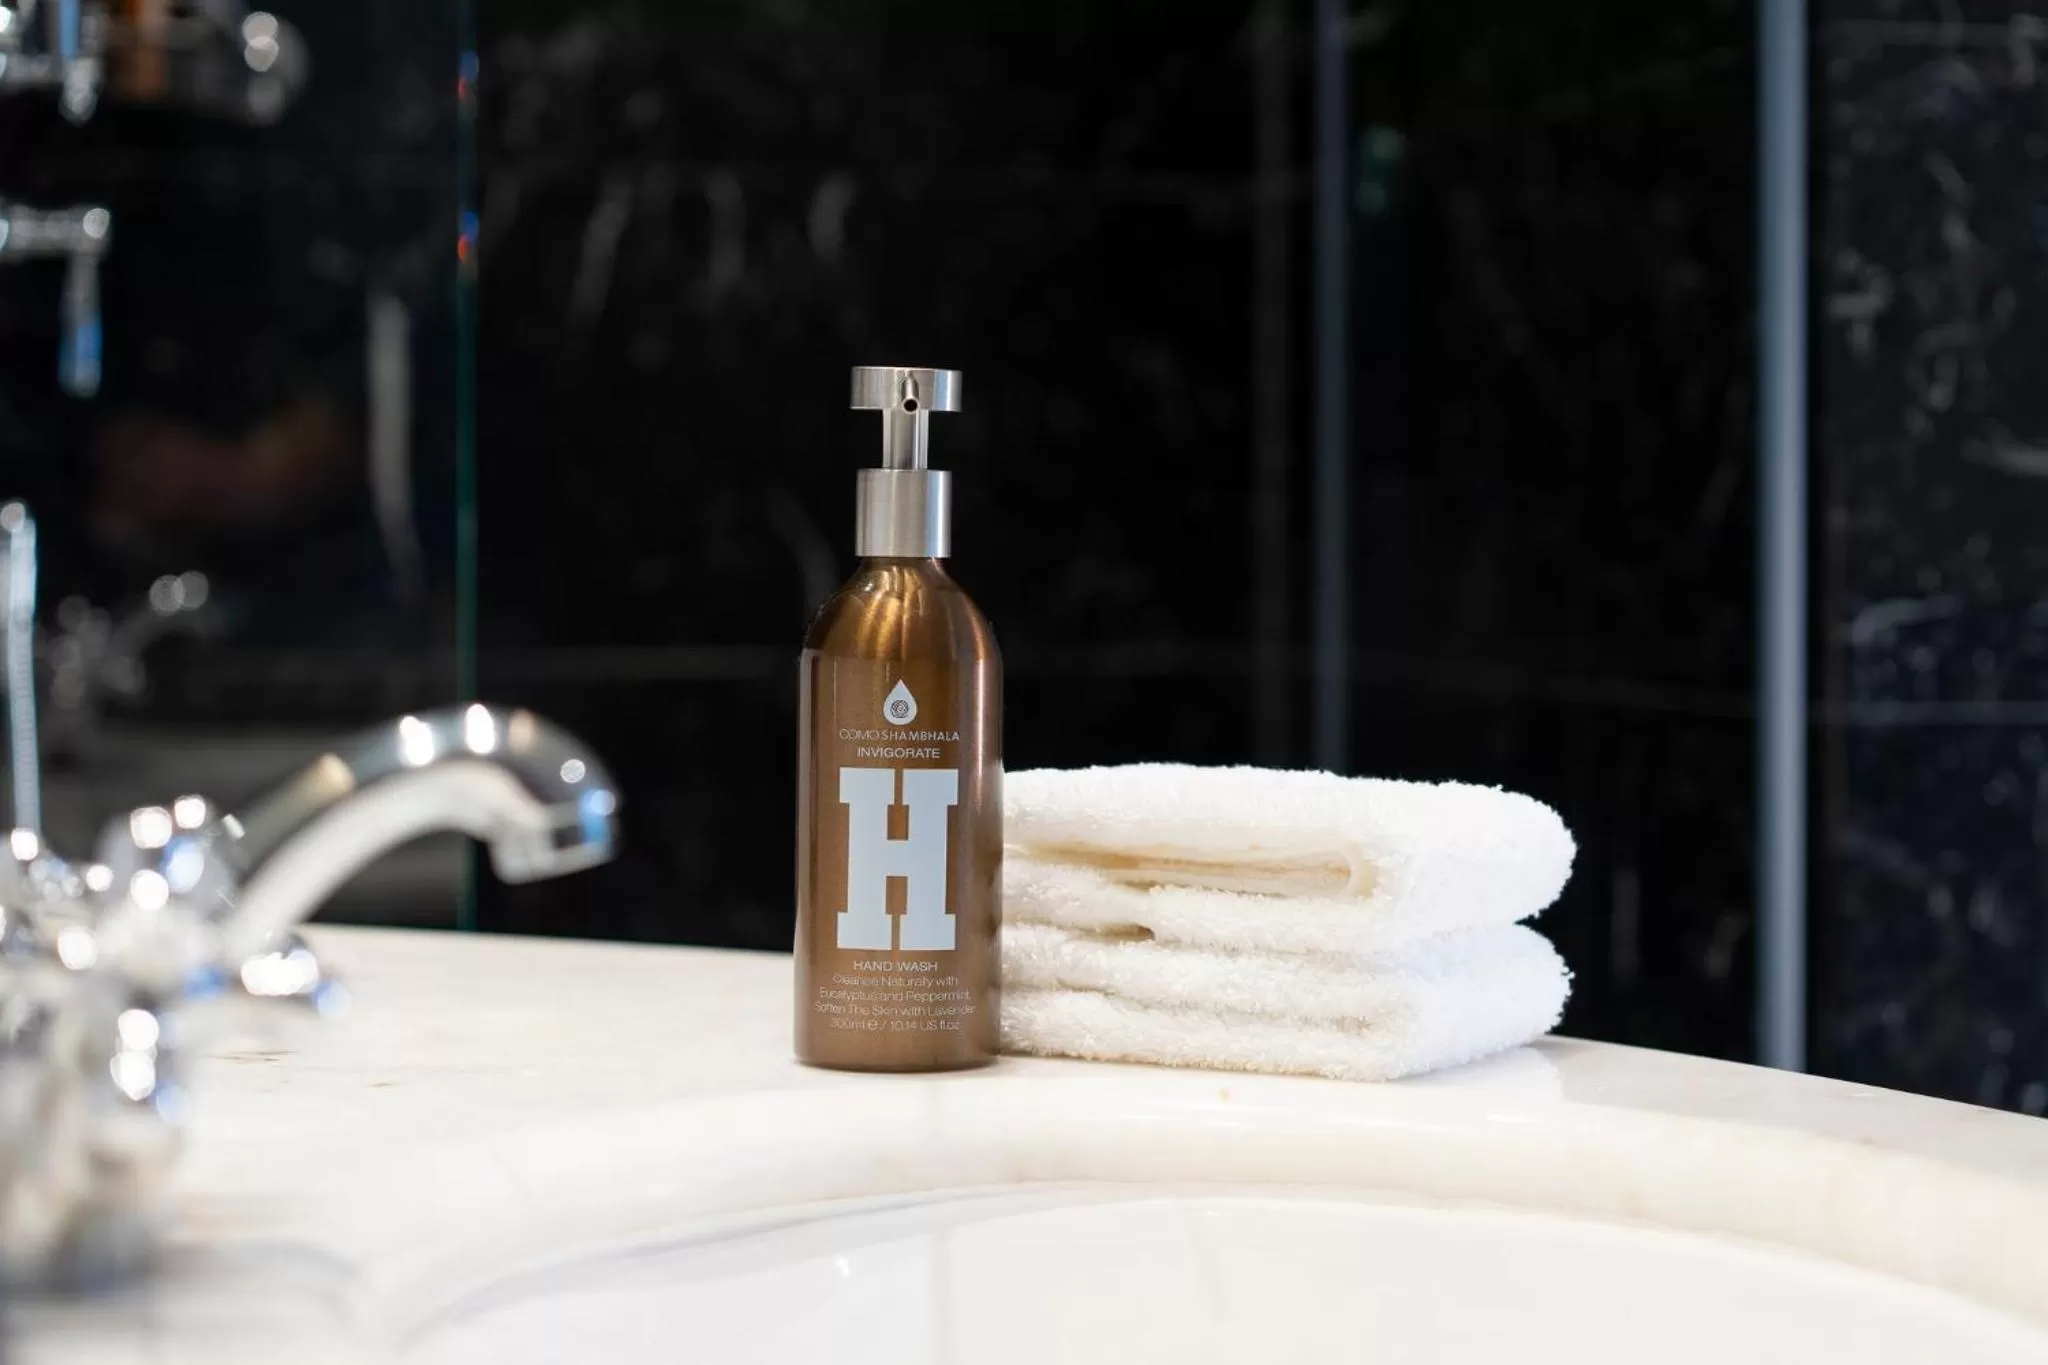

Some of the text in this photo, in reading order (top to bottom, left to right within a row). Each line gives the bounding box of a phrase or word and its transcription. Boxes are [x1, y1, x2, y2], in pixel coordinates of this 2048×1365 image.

[881, 729, 960, 742] SHAMBHALA
[857, 747, 941, 759] INVIGORATE
[838, 767, 959, 950] H
[853, 960, 938, 972] HAND WASH
[881, 974, 933, 988] Naturally
[936, 975, 959, 986] with
[819, 986, 879, 1001] Eucalyptus
[880, 990, 903, 1001] and
[815, 1001, 846, 1014] Soften
[848, 1003, 869, 1015] The
[872, 1004, 898, 1016] Skin
[900, 1004, 927, 1016] with
[921, 1020, 937, 1031] US
